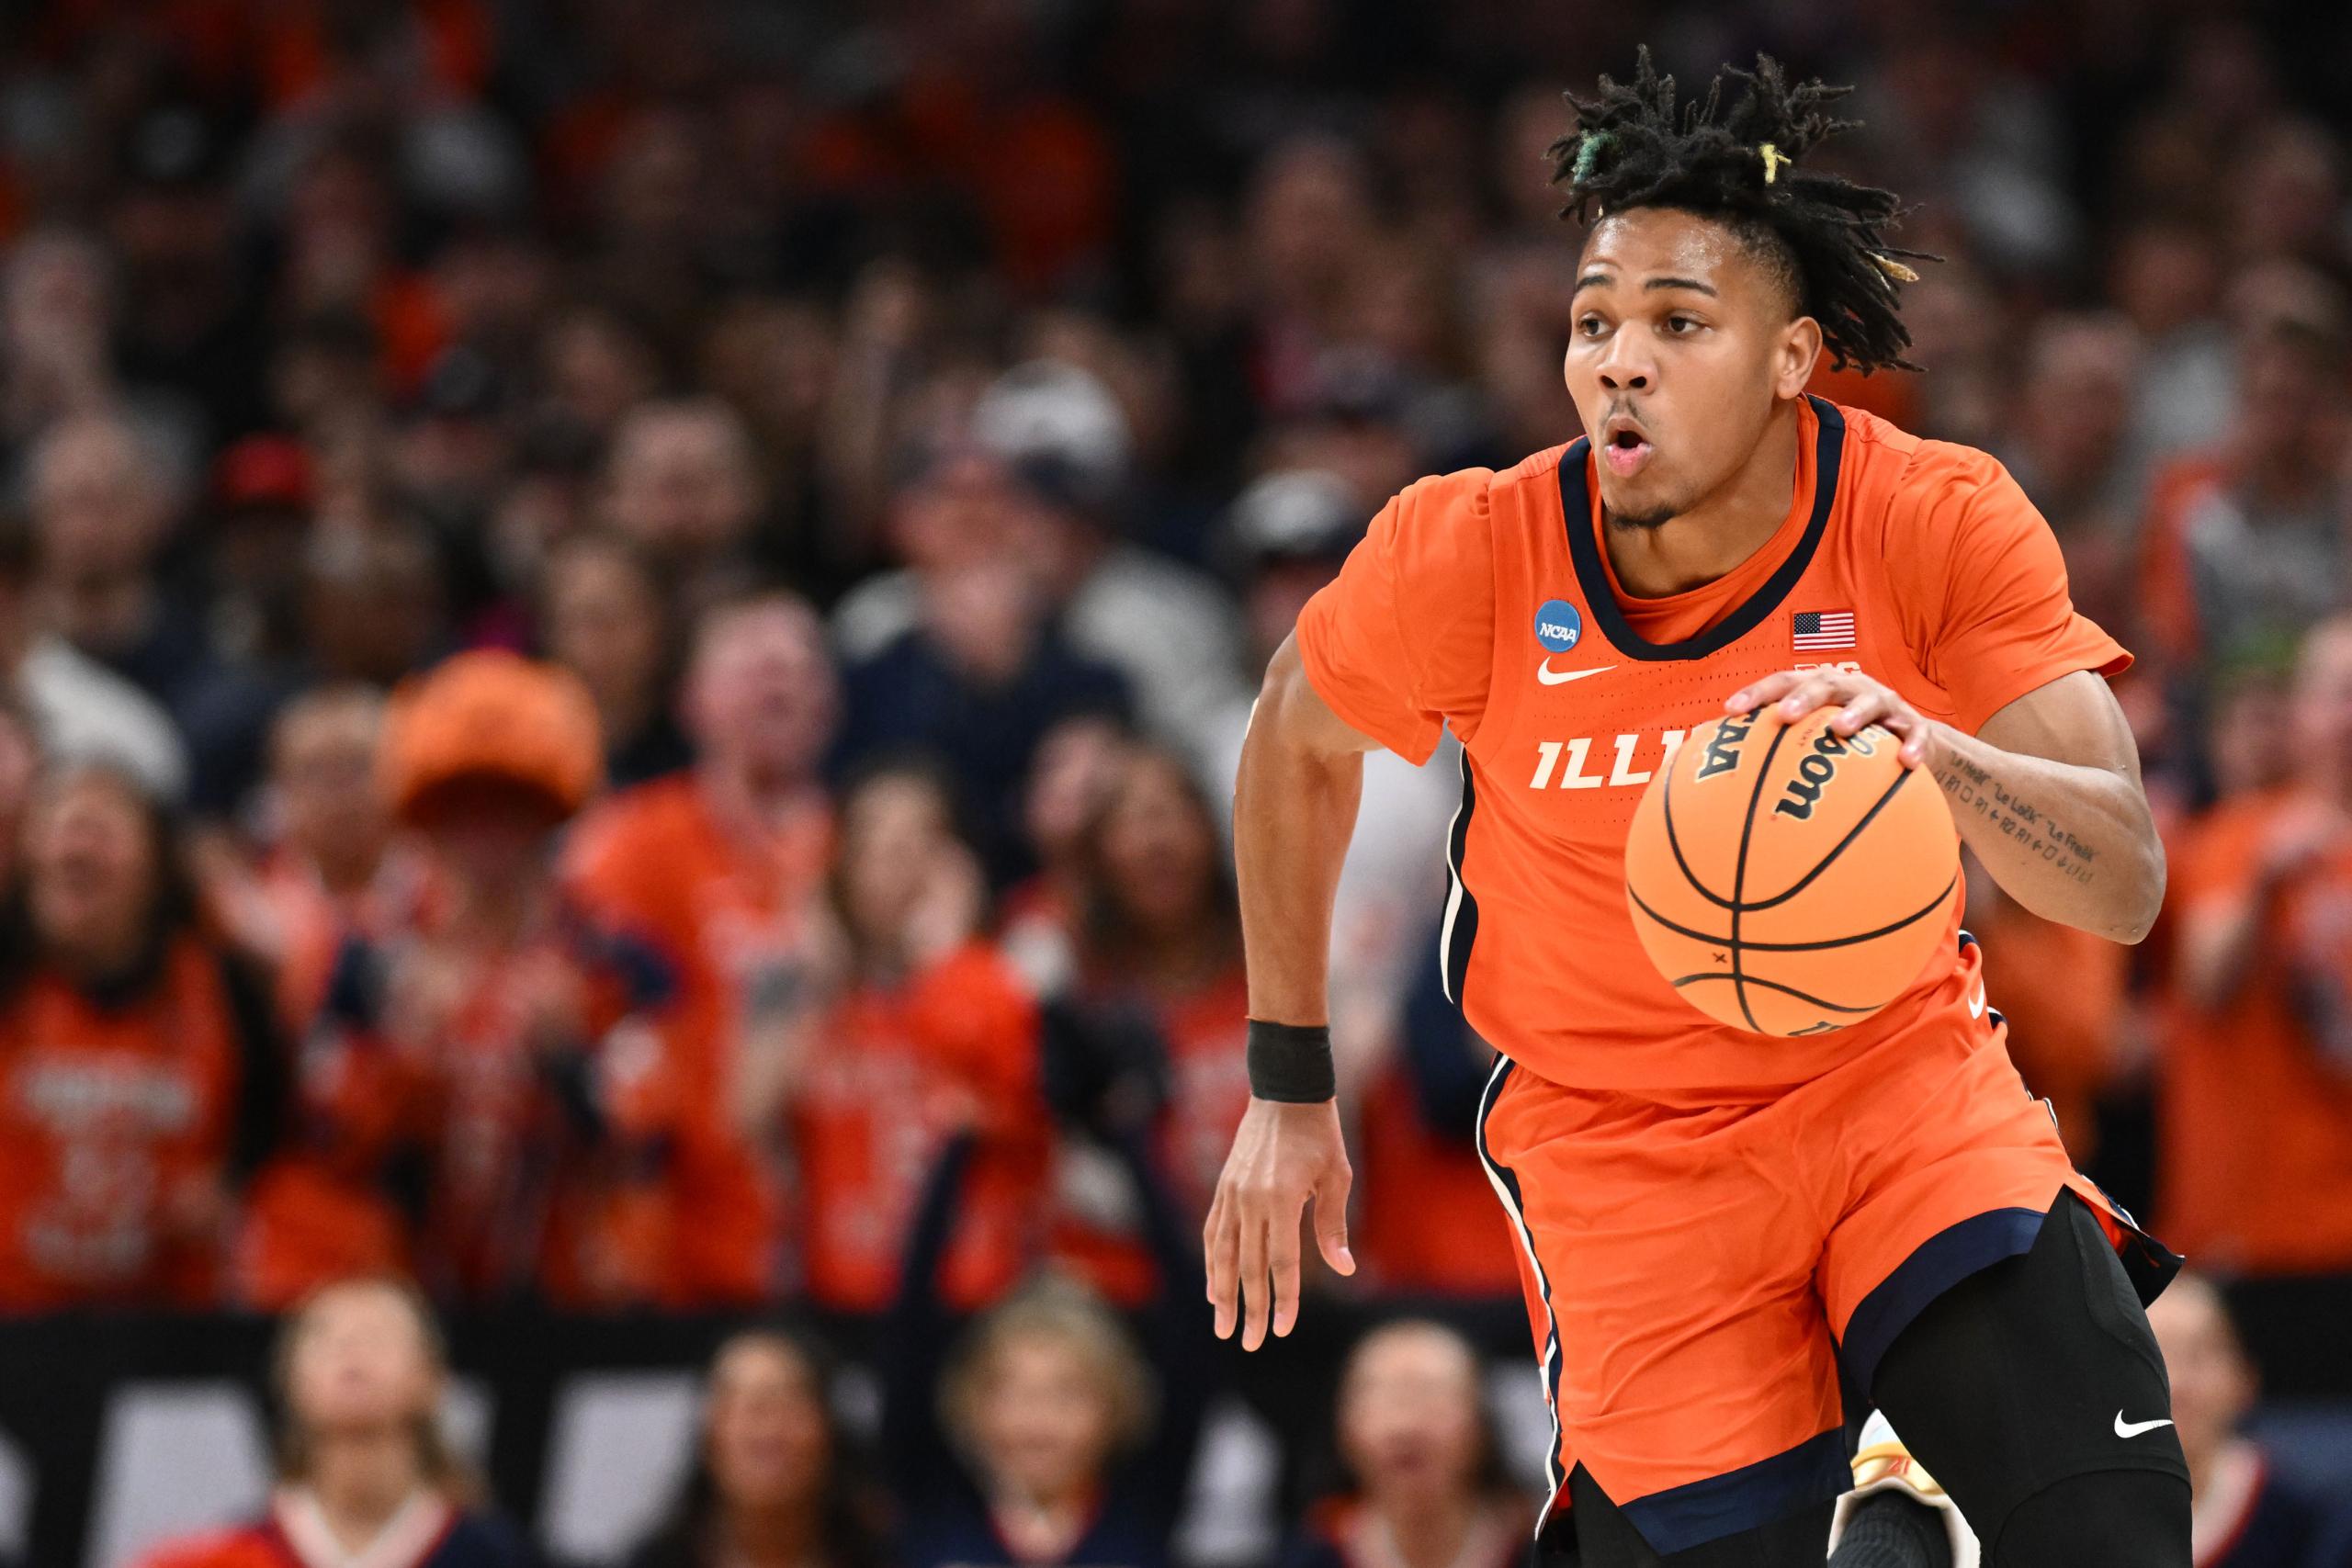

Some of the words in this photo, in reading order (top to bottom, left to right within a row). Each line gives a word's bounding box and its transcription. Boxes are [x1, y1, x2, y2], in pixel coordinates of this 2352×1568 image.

[1539, 622, 1577, 643] NCAA
[1529, 729, 1686, 790] ILLI
[1697, 705, 1761, 781] AA
